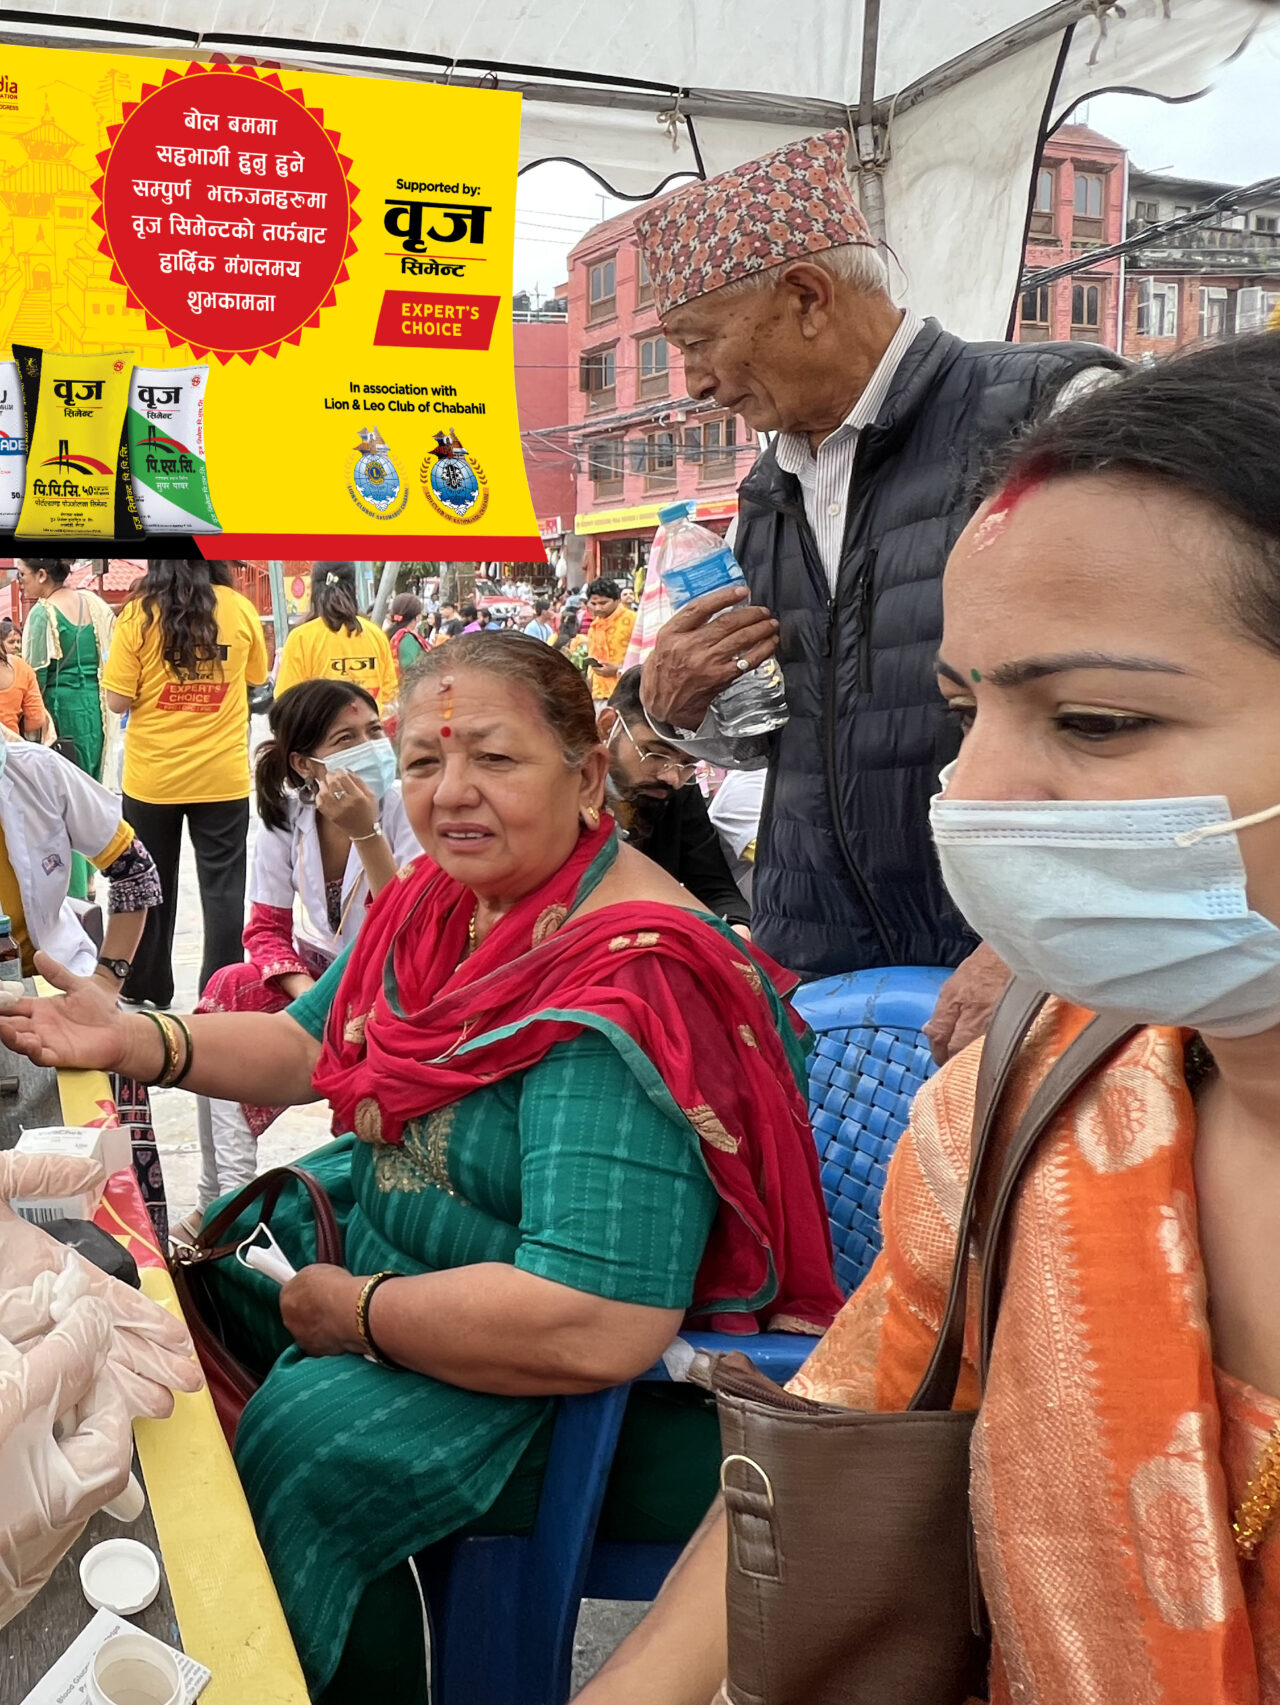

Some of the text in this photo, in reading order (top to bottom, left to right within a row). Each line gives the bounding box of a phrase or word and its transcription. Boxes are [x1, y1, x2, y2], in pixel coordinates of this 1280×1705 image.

[183, 107, 278, 136] बोल बममा
[155, 145, 305, 177] सहभागी हुनु हुने
[131, 179, 192, 205] सम्पुर्ण
[396, 178, 481, 197] Supported by:
[131, 212, 328, 244] वृज सिमेन्टको तर्फबाट
[384, 199, 492, 253] वृज
[158, 249, 301, 278] हार्दिक मंगलमय
[401, 256, 466, 277] सिमेन्ट
[186, 291, 277, 315] शुभकामना
[401, 302, 480, 320] EXPERT'S
[401, 321, 462, 337] CHOICE
[53, 379, 106, 407] वृज
[137, 385, 183, 410] वृज
[349, 381, 458, 397] In association with
[324, 398, 486, 415] Lion & Leo Club of Chabahil
[11, 491, 21, 499] 50
[168, 693, 211, 703] CHOICE
